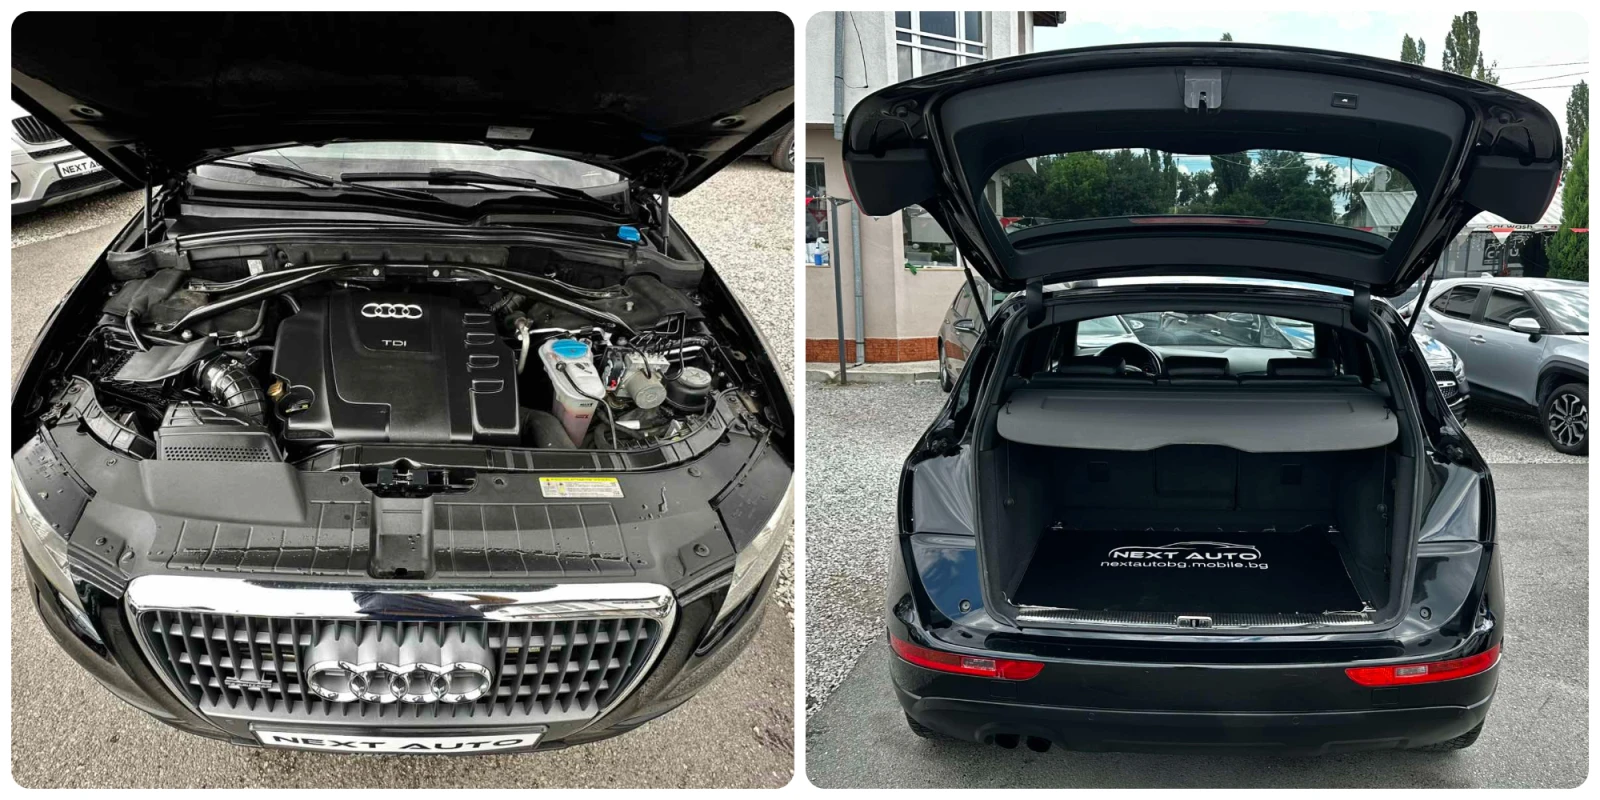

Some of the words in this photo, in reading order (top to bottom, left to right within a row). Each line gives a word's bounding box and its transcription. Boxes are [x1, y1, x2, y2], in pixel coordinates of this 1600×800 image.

[62, 162, 87, 175] NEXT
[381, 339, 407, 347] TDI
[1113, 551, 1179, 559] NEXT
[1185, 552, 1258, 560] AUTO
[1100, 560, 1269, 570] nextautobg.mobile.bg
[272, 735, 386, 749] NEXT
[399, 738, 524, 750] AUTO
